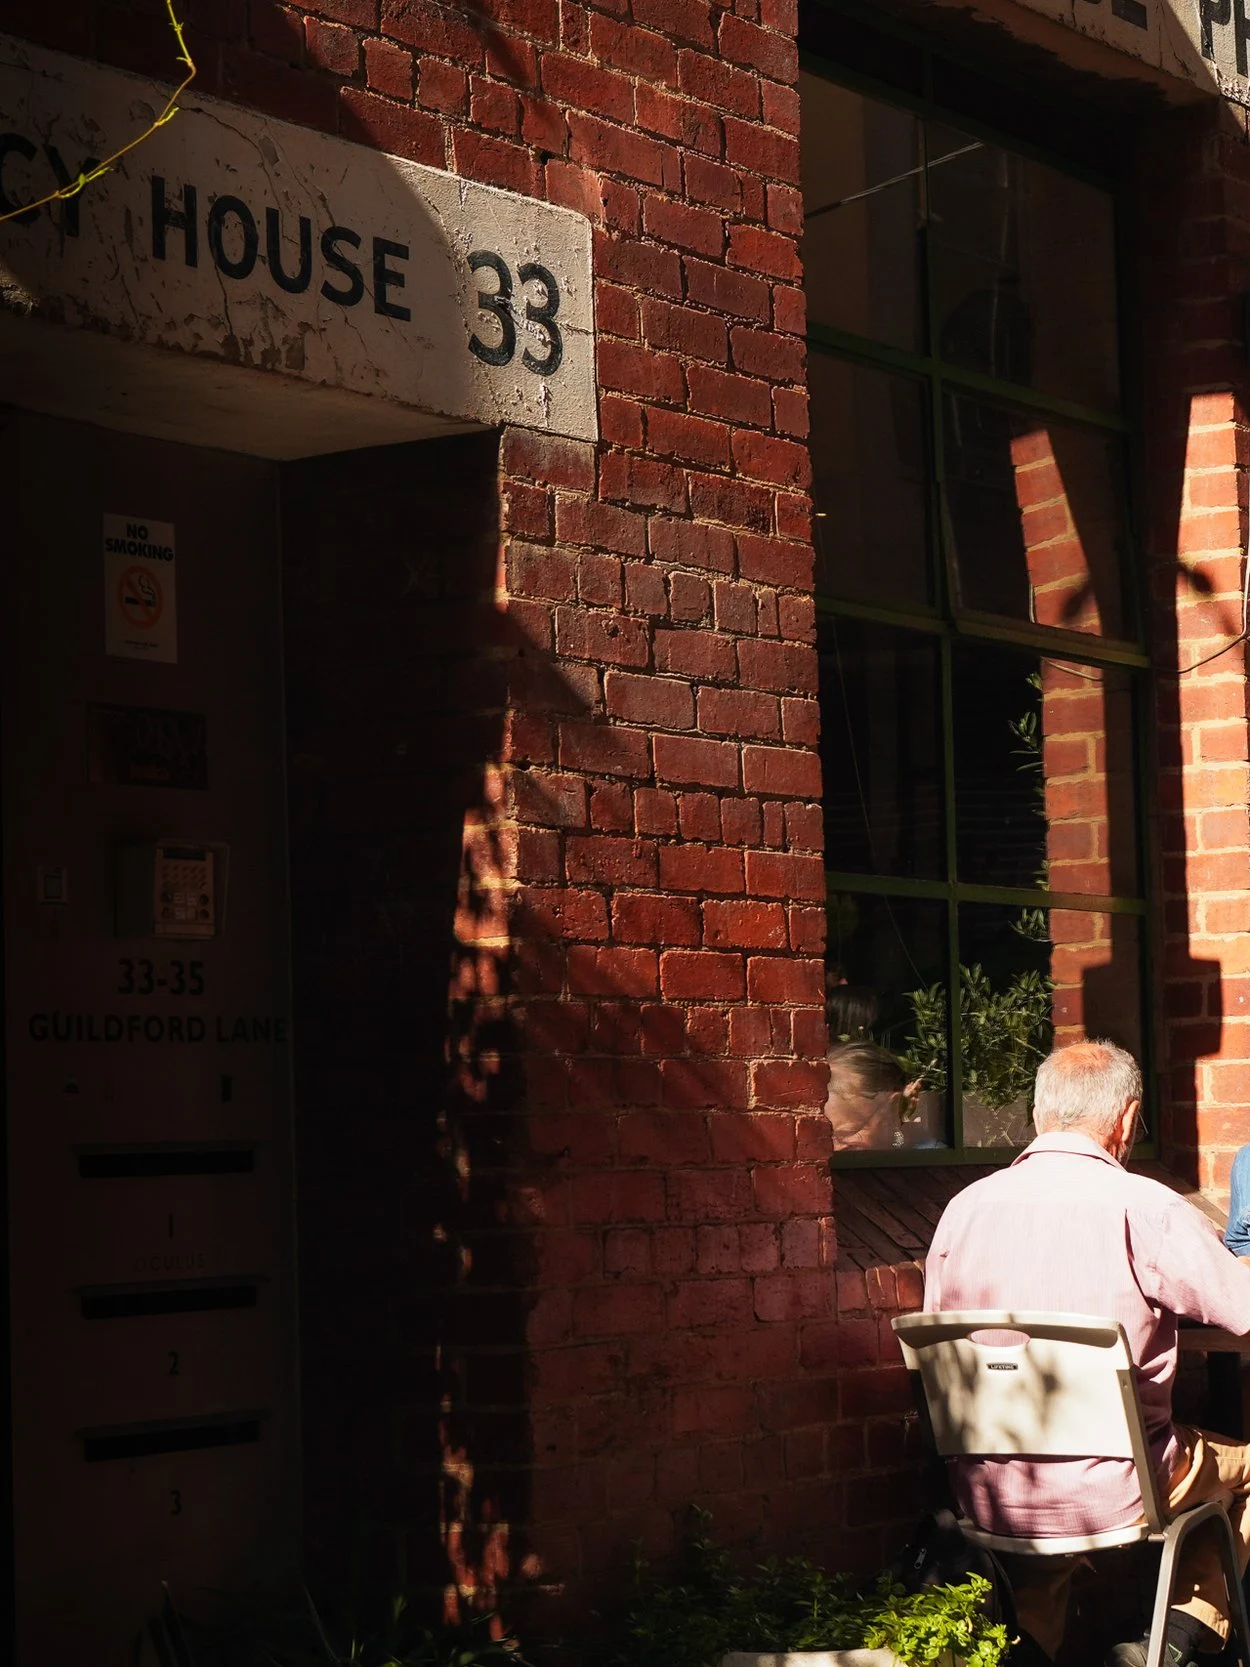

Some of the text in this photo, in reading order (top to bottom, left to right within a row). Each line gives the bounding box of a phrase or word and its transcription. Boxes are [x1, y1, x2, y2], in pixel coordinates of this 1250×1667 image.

[152, 175, 412, 322] HOUSE
[466, 249, 564, 376] 33
[126, 523, 149, 540] NO
[105, 538, 174, 562] SMOKING
[118, 958, 205, 996] 33-35
[29, 1011, 288, 1044] GUILDFORD LANE
[167, 1351, 180, 1377] 2
[169, 1489, 181, 1515] 3
